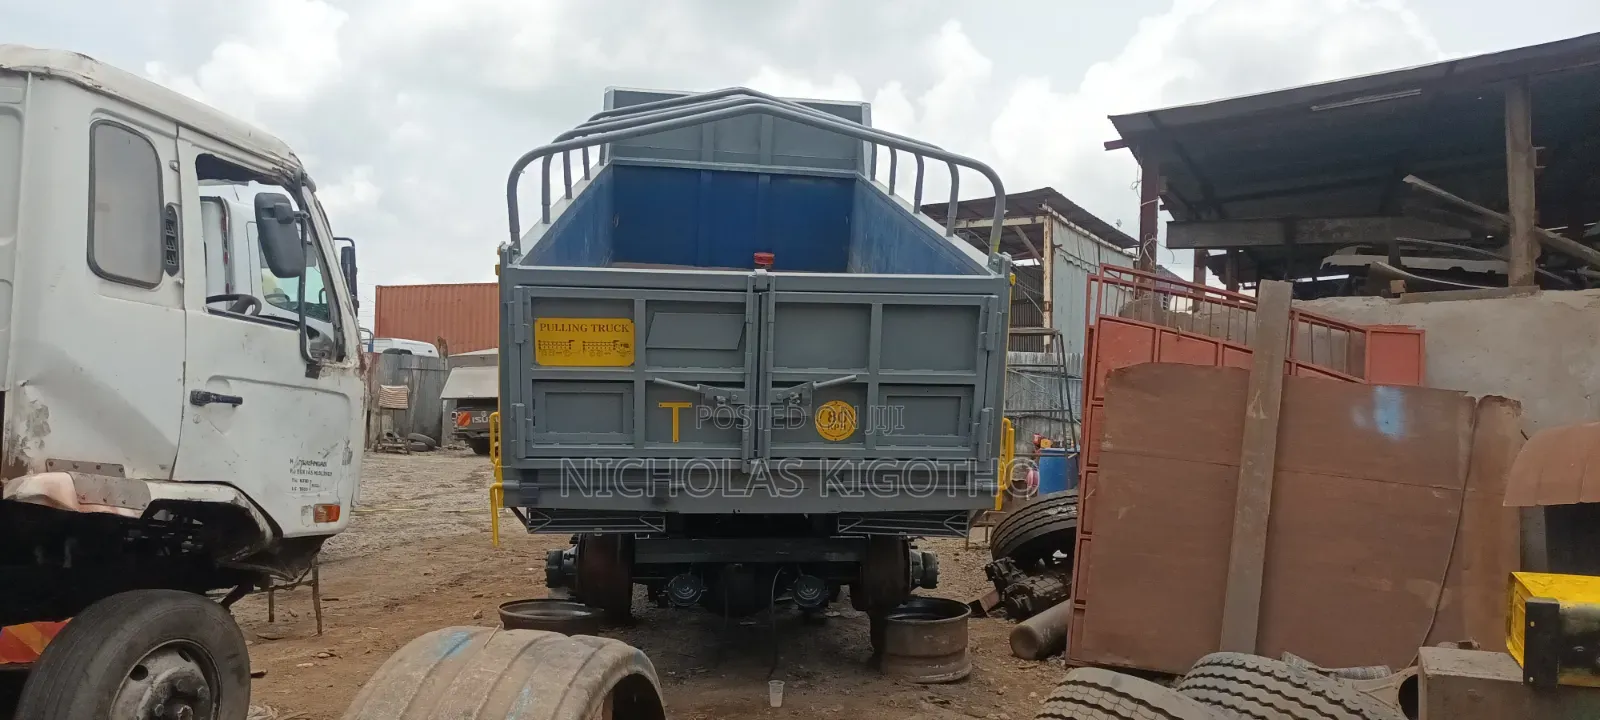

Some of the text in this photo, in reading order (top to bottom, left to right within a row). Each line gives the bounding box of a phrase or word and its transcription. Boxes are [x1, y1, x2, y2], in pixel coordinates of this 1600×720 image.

[539, 322, 630, 333] PULLING TRUCK
[472, 416, 500, 424] ISU
[658, 402, 693, 443] T
